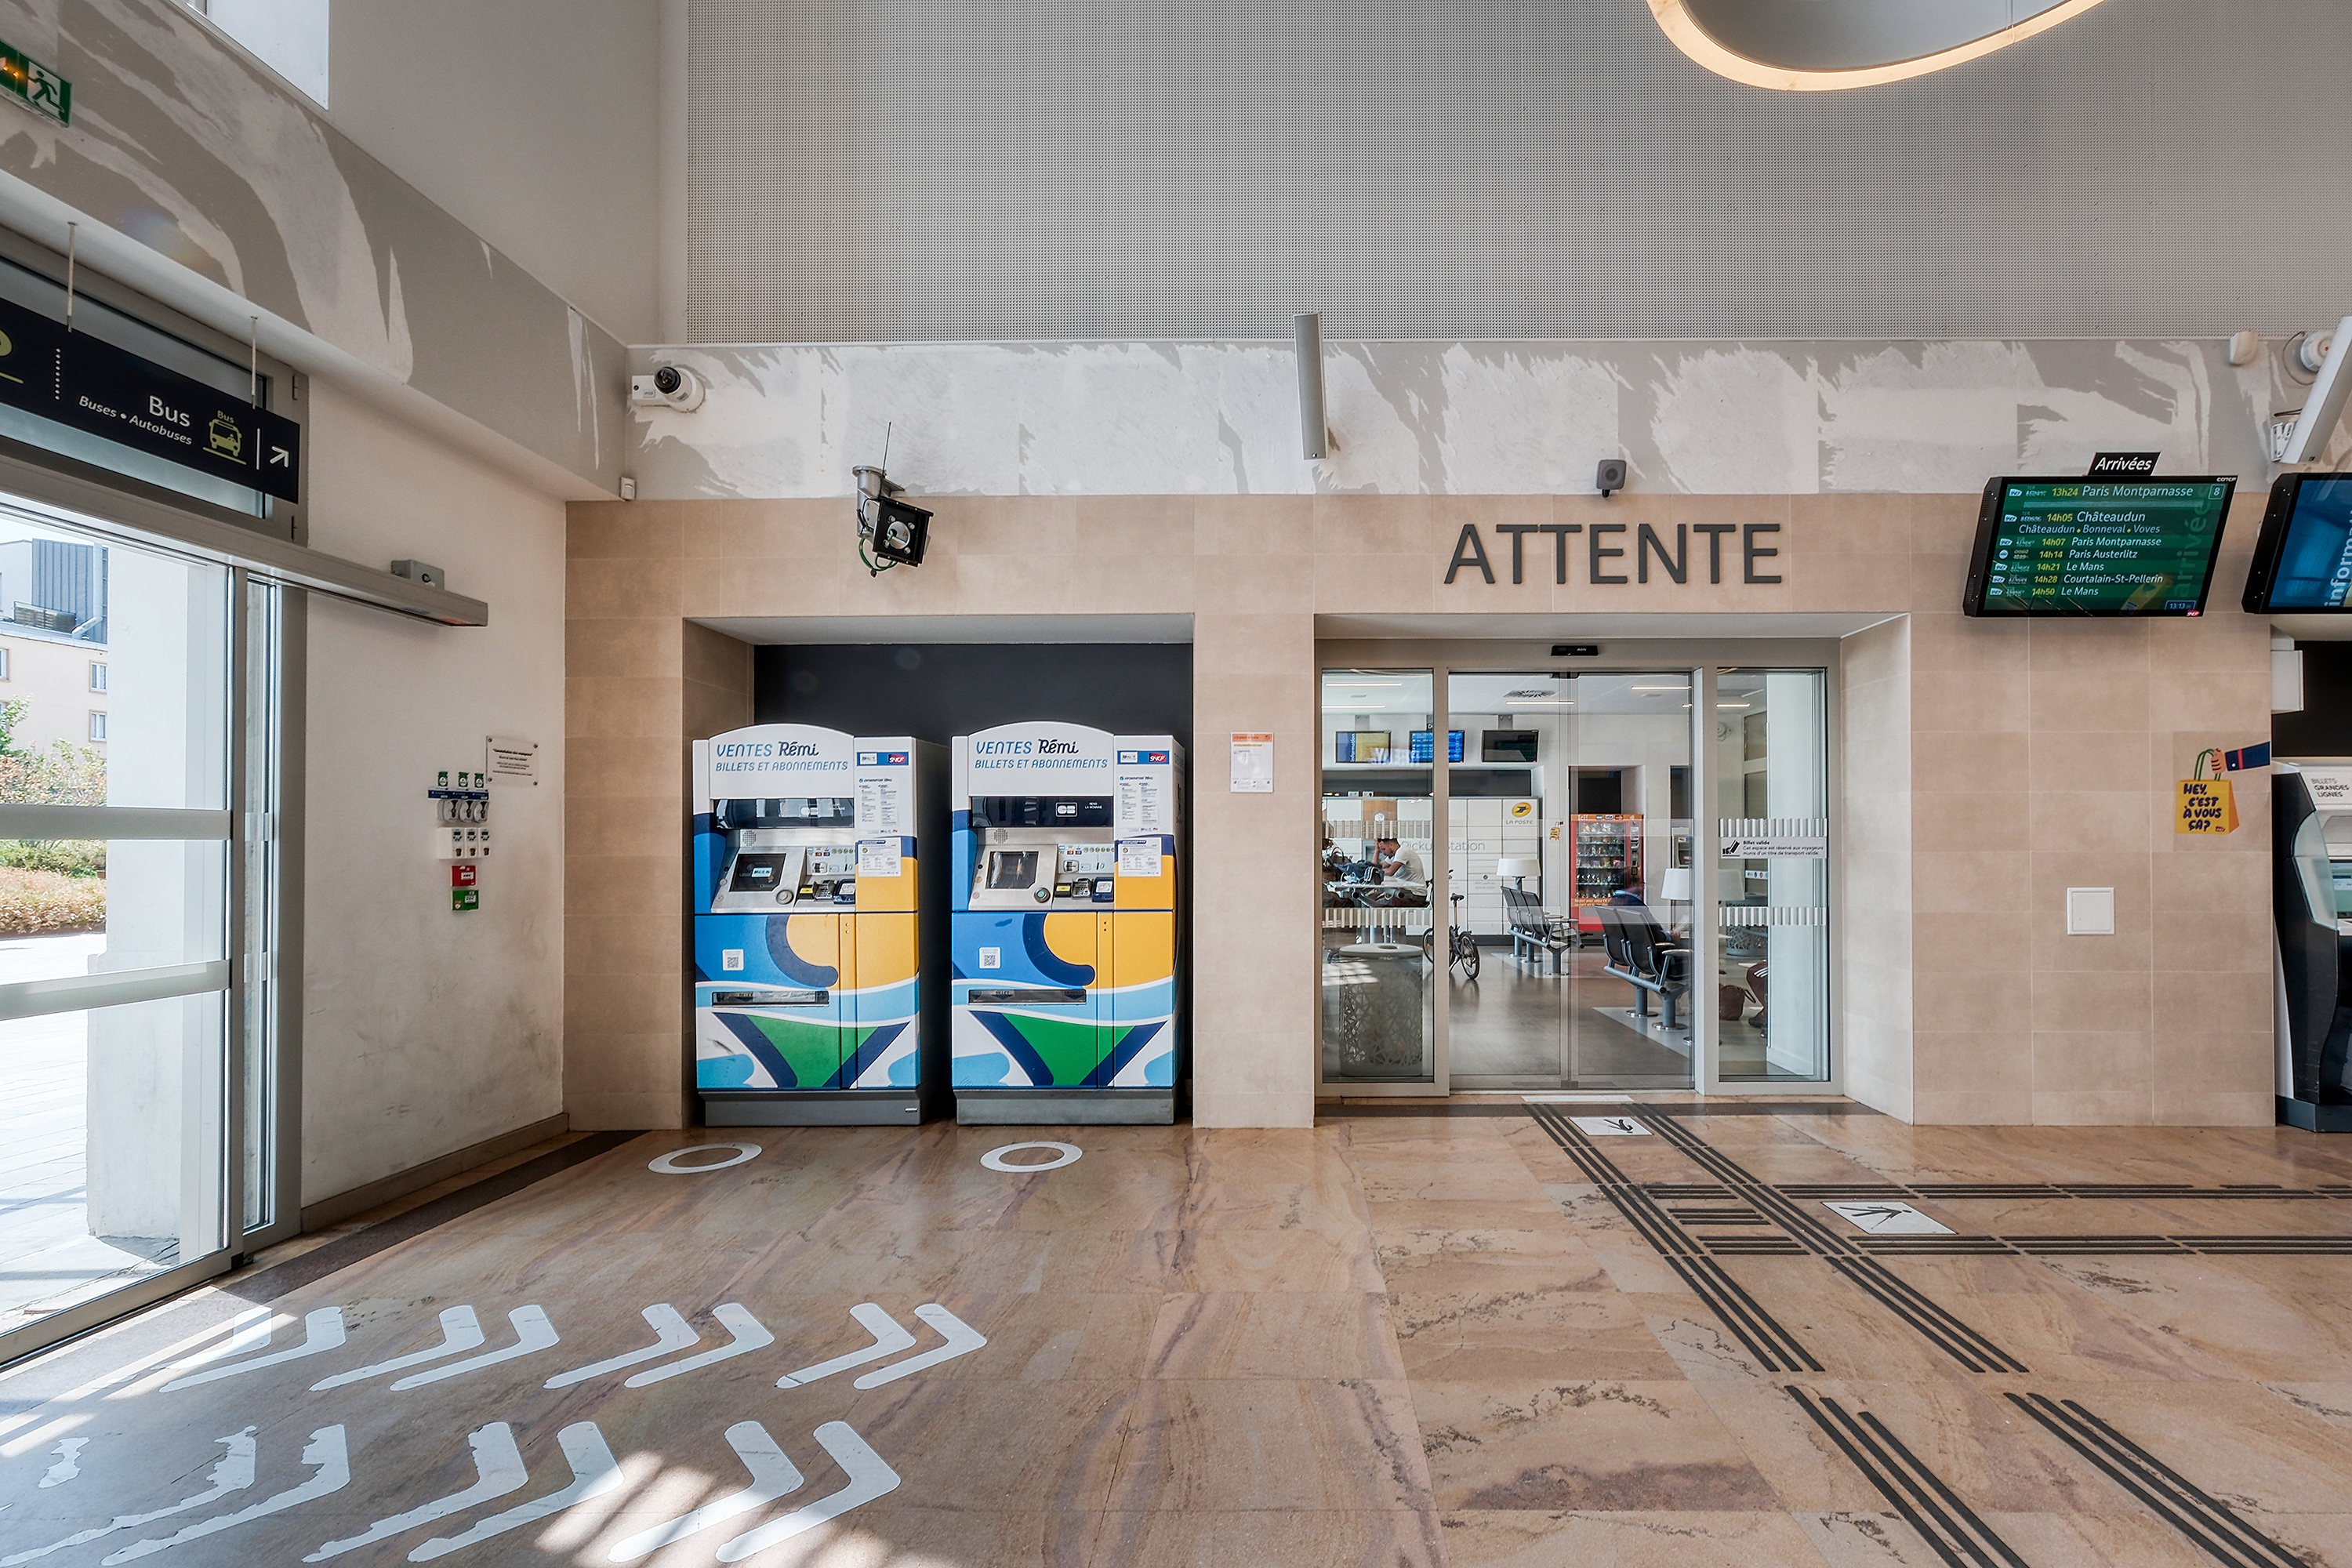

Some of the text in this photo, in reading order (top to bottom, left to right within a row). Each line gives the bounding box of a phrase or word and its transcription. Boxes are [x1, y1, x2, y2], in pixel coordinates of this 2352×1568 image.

[149, 395, 191, 427] Bus
[217, 410, 235, 423] Bus
[79, 395, 193, 445] Buses Autobuses
[2095, 456, 2152, 471] Arrivées
[2052, 488, 2078, 496] 13h24
[2082, 485, 2109, 496] Paris
[2112, 485, 2194, 499] Montparnasse
[2213, 487, 2220, 495] 8
[2046, 514, 2073, 522] 14h05
[2077, 511, 2146, 522] Châteaudun
[2019, 524, 2160, 533] Châteaudun Bonneval Voves
[2071, 537, 2093, 546] Paris
[2096, 537, 2161, 547] Montparnasse
[1443, 524, 1782, 584] ATTENTE
[2069, 549, 2091, 558] Paris
[2092, 550, 2138, 559] Austerlitz
[2324, 510, 2352, 606] inform
[2066, 562, 2078, 571] Le
[2063, 574, 2163, 583] Courtalain-St-Pellerin
[2074, 587, 2099, 596] Mans
[717, 741, 819, 757] VENTES Rémi
[976, 739, 1079, 755] VENTES Rémi
[716, 761, 848, 771] BILLETS ET ABONNEMENTS
[975, 759, 1108, 769] BILLETS ET ABONNEMENTS
[2188, 797, 2219, 808] C'EST
[2183, 805, 2222, 818] À VOUS
[2188, 819, 2211, 832] ÇA?
[1448, 842, 1485, 851] tation
